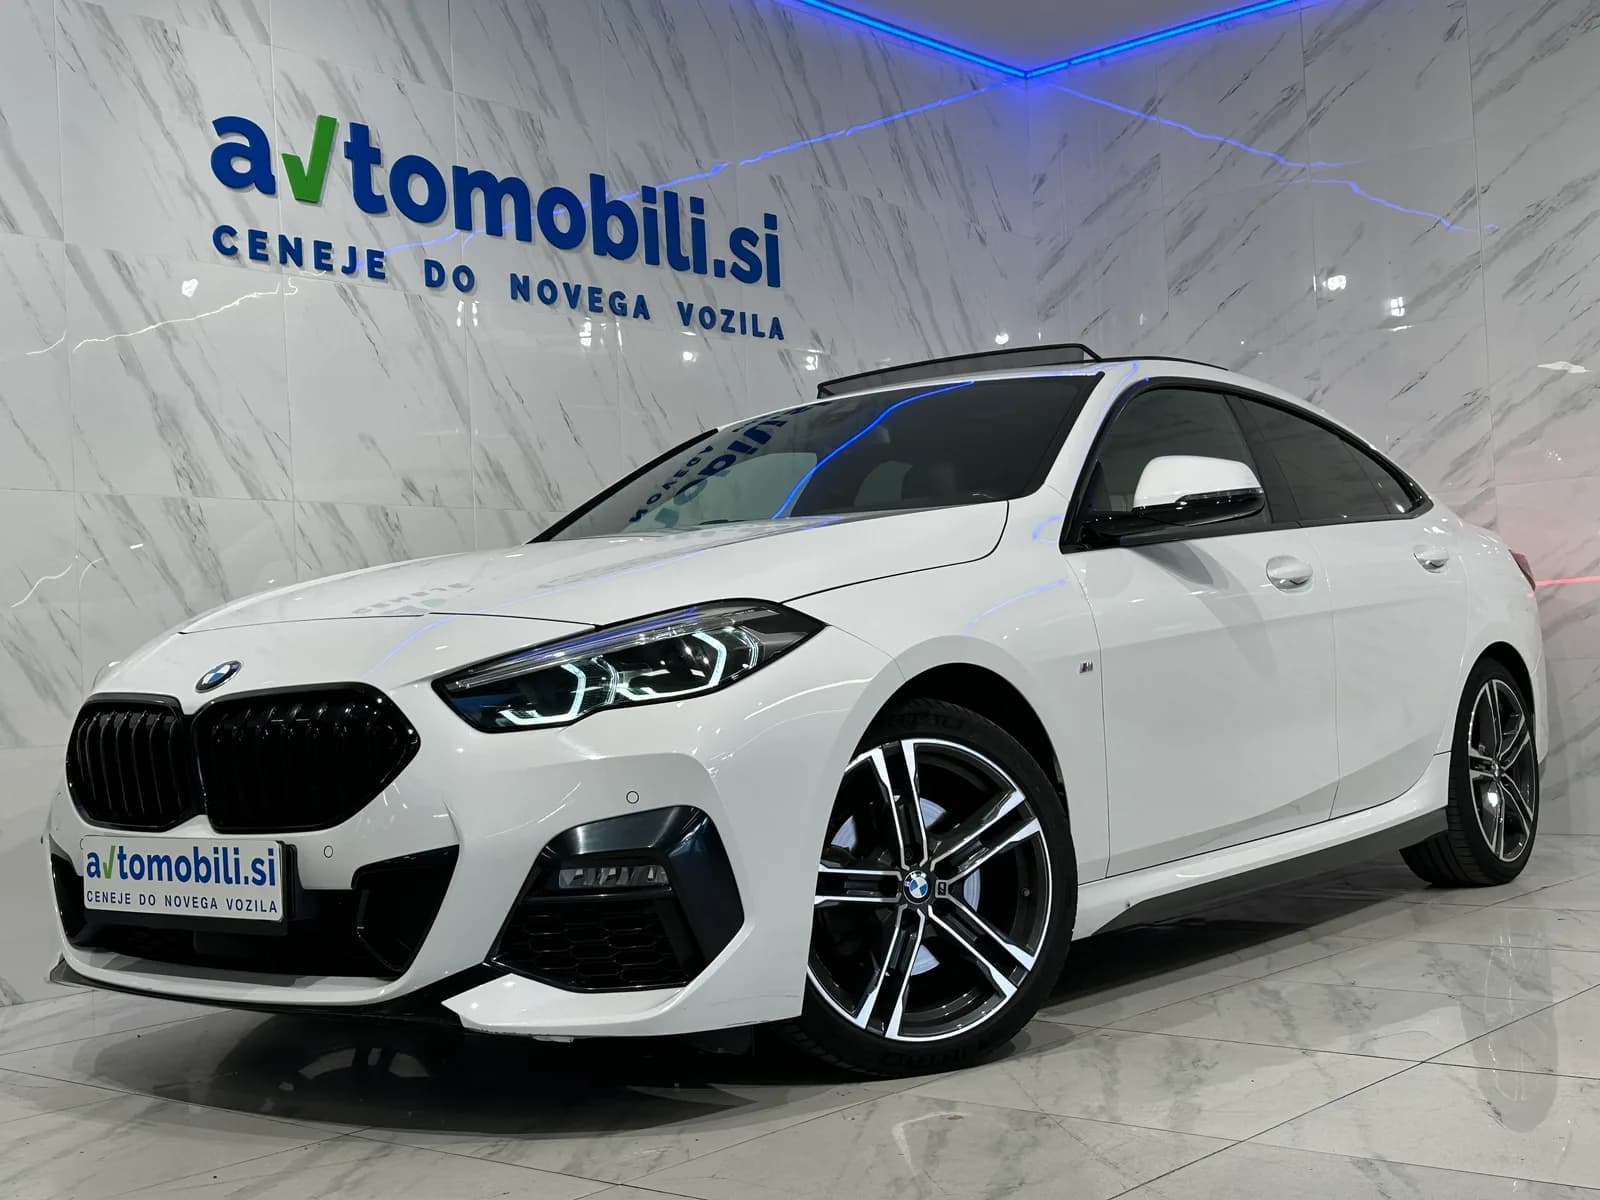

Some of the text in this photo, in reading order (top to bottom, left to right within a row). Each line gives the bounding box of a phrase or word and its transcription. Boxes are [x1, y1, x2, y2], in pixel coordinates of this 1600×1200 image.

[212, 225, 784, 340] CENEJE DO NOVEGA VOZILA
[86, 890, 278, 913] CENEJE DO NOVEGA VOZILA
